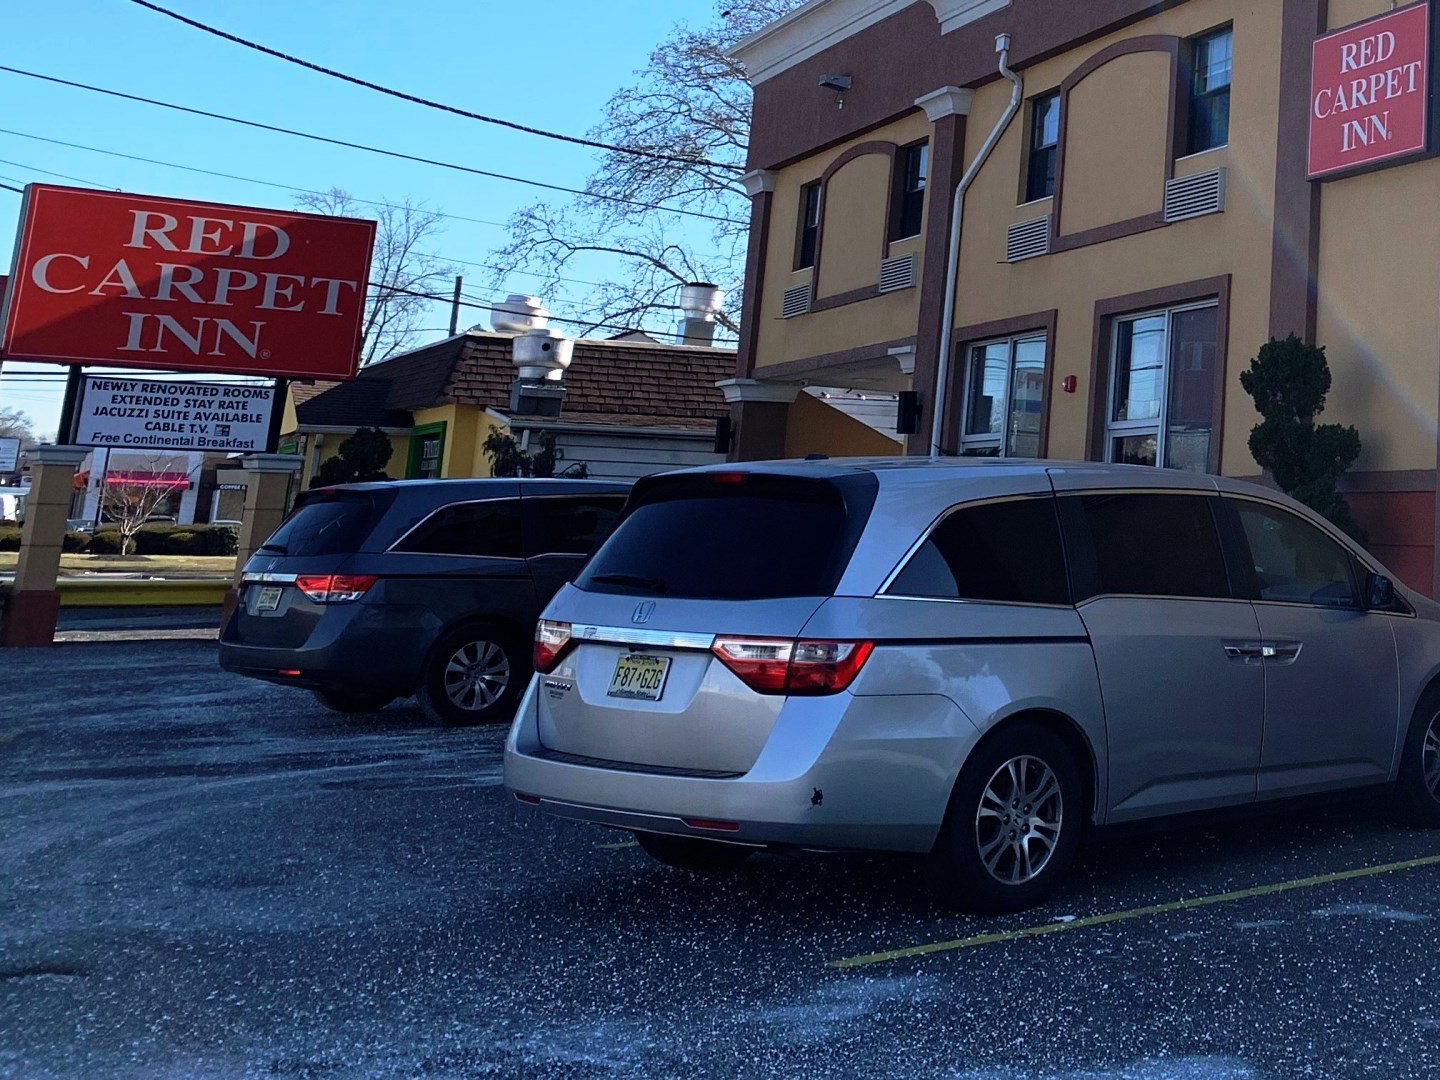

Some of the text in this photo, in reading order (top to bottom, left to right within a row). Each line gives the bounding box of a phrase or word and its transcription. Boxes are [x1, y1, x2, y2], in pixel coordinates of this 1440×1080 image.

[1339, 31, 1395, 74] RED
[1314, 61, 1422, 119] CARPET
[123, 209, 290, 260] RED
[32, 253, 357, 316] CARPET
[91, 380, 270, 400] NEWLY RENOVATED ROOMS
[111, 395, 249, 411] EXTENDED STAY RATE
[92, 407, 263, 423] JACUZZI SUITE AVAILABLE
[144, 422, 185, 433] CABLE
[189, 424, 209, 434] T.V.
[91, 432, 255, 449] Free Continental Breakfast
